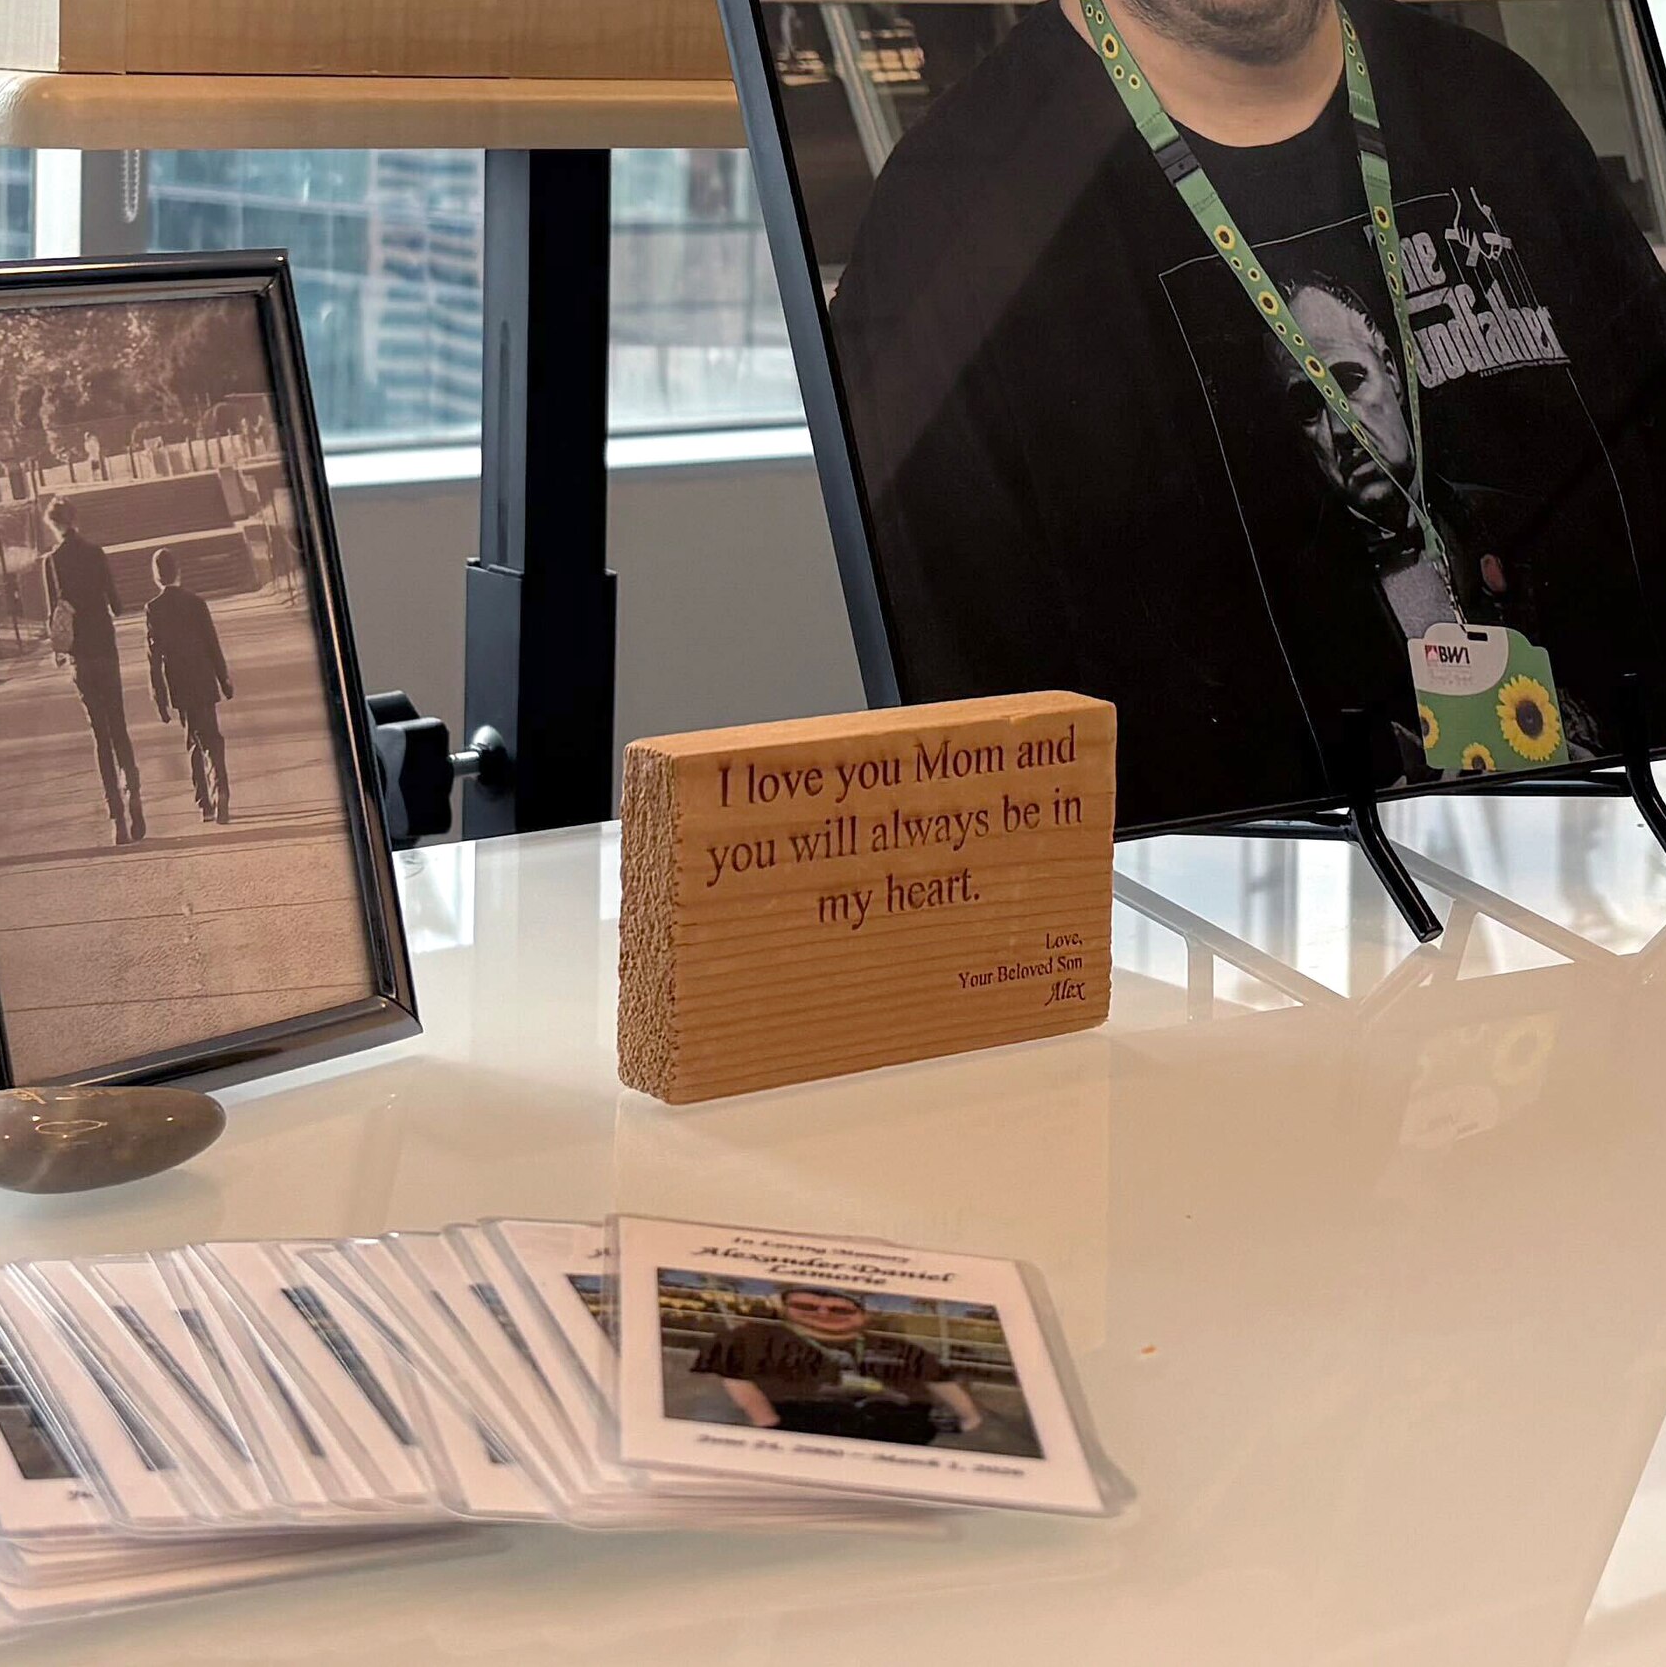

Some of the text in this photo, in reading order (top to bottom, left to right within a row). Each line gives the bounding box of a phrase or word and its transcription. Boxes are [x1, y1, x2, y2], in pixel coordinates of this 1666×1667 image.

[1438, 645, 1471, 664] BWI
[719, 723, 1076, 807] I love you Mom and
[706, 787, 1083, 888] you will always be in
[818, 868, 981, 931] my heart.
[1046, 932, 1083, 950] Love,
[958, 955, 1083, 989] Your Beloved Son
[1044, 978, 1086, 1007] Alex
[690, 1246, 958, 1283] Alexander Daniel
